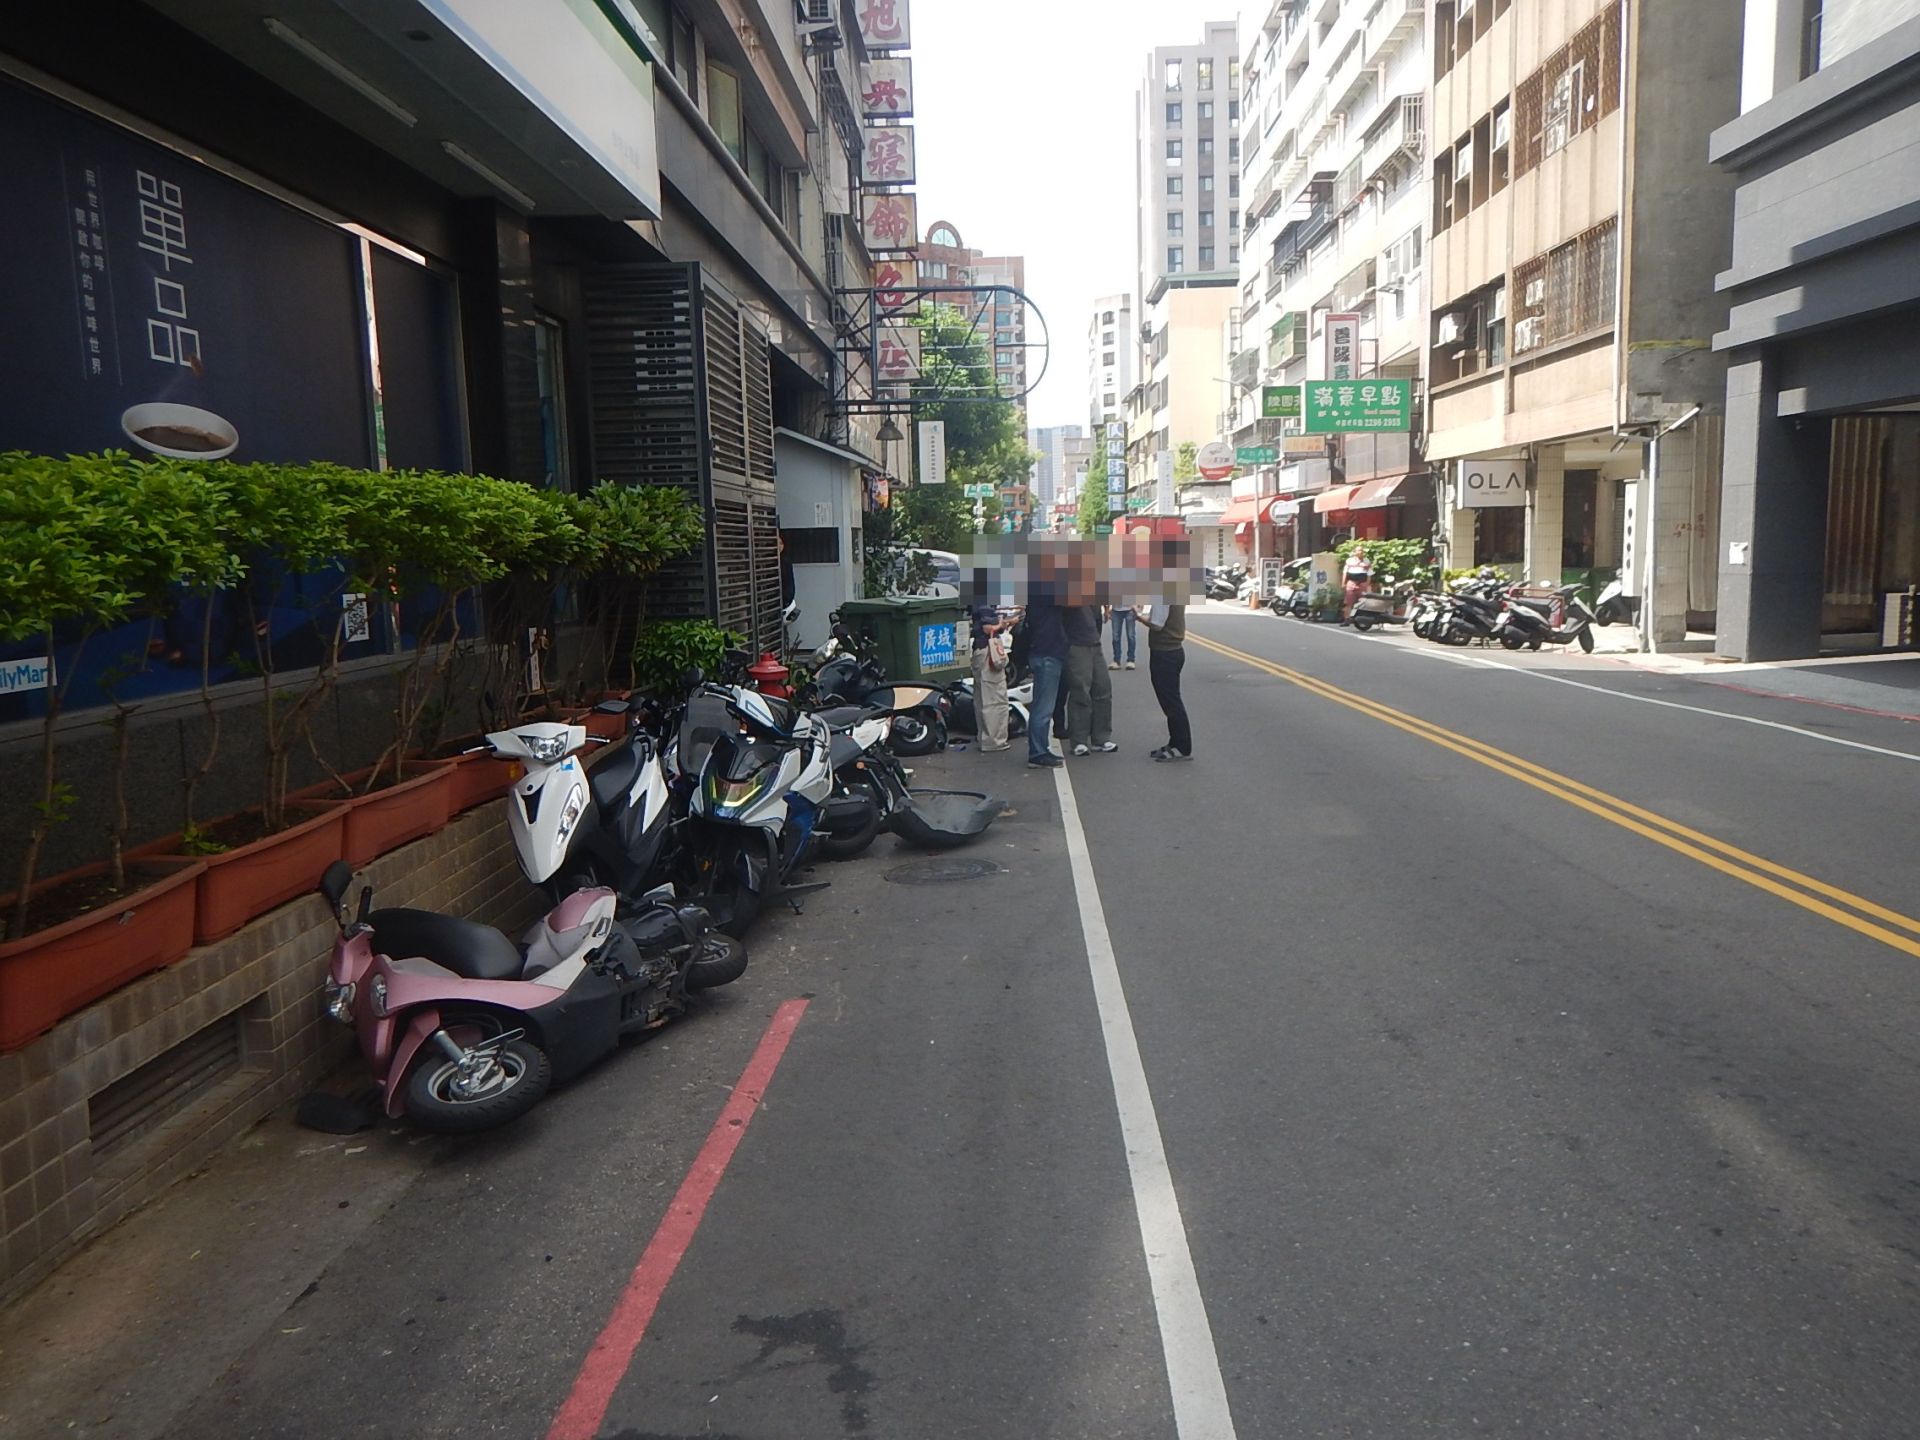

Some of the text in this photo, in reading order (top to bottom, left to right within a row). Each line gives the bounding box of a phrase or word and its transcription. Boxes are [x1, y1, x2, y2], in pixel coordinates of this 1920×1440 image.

[136, 169, 200, 368] 單品
[1314, 385, 1402, 407] 滿意早點
[1467, 472, 1521, 490] OLA
